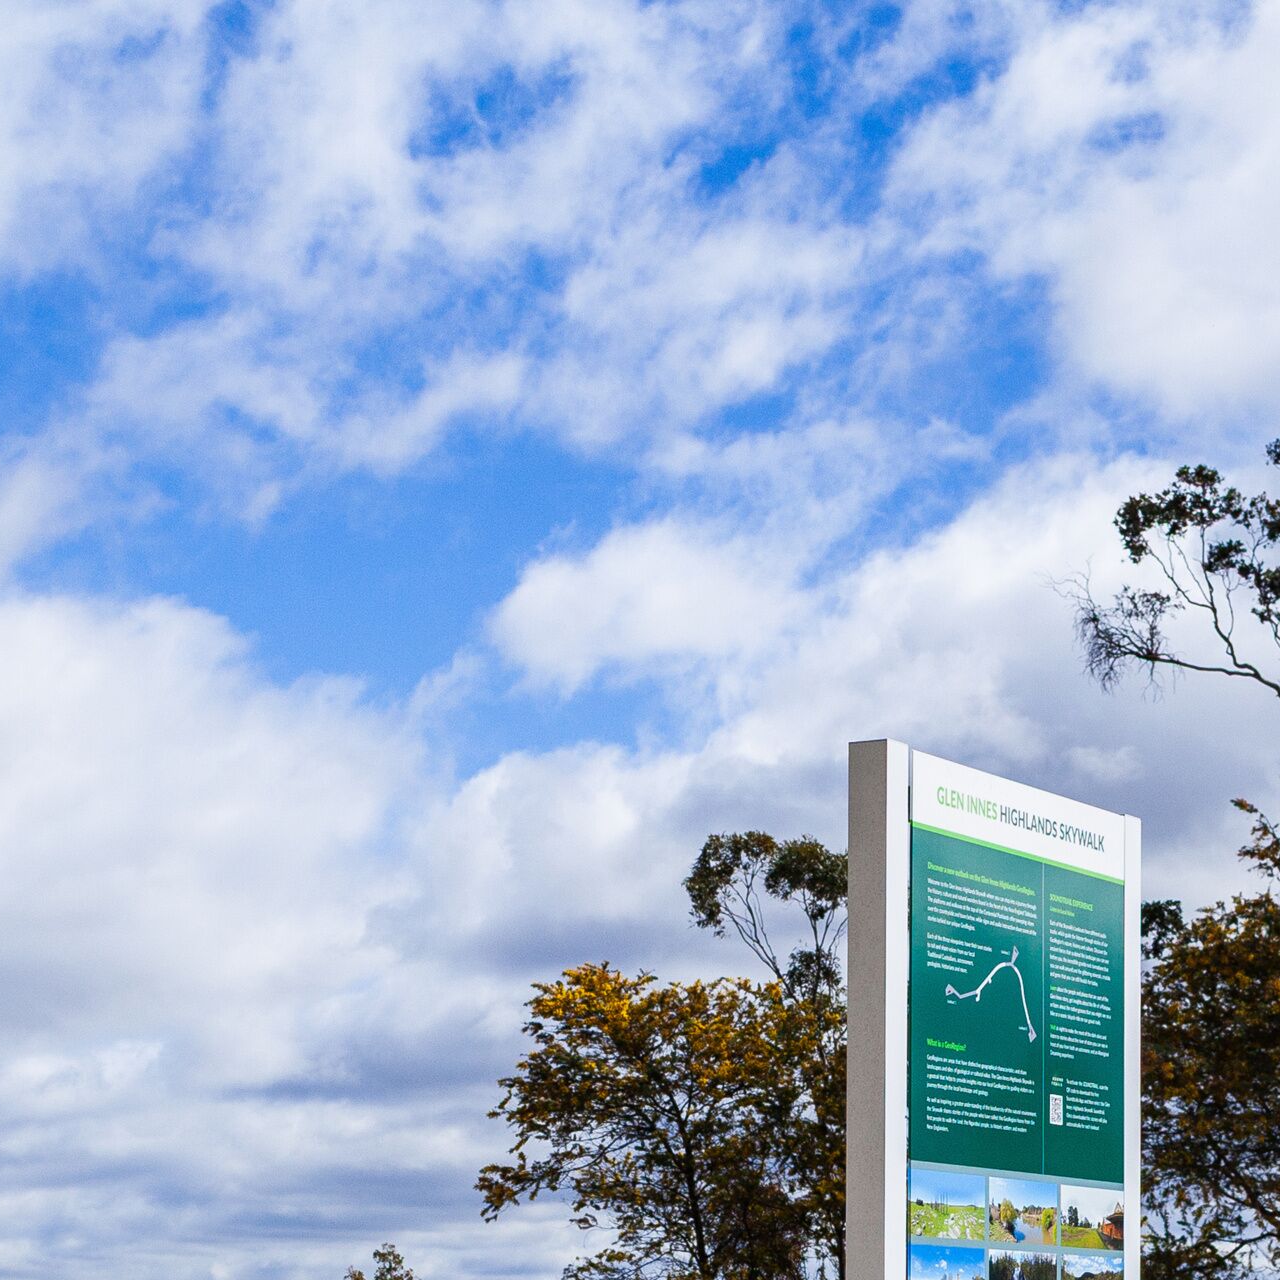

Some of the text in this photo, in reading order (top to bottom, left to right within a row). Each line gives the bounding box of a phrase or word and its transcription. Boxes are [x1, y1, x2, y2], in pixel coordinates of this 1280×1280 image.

[936, 786, 1105, 853] GLEN INNES HIGHLANDS SKYWALK
